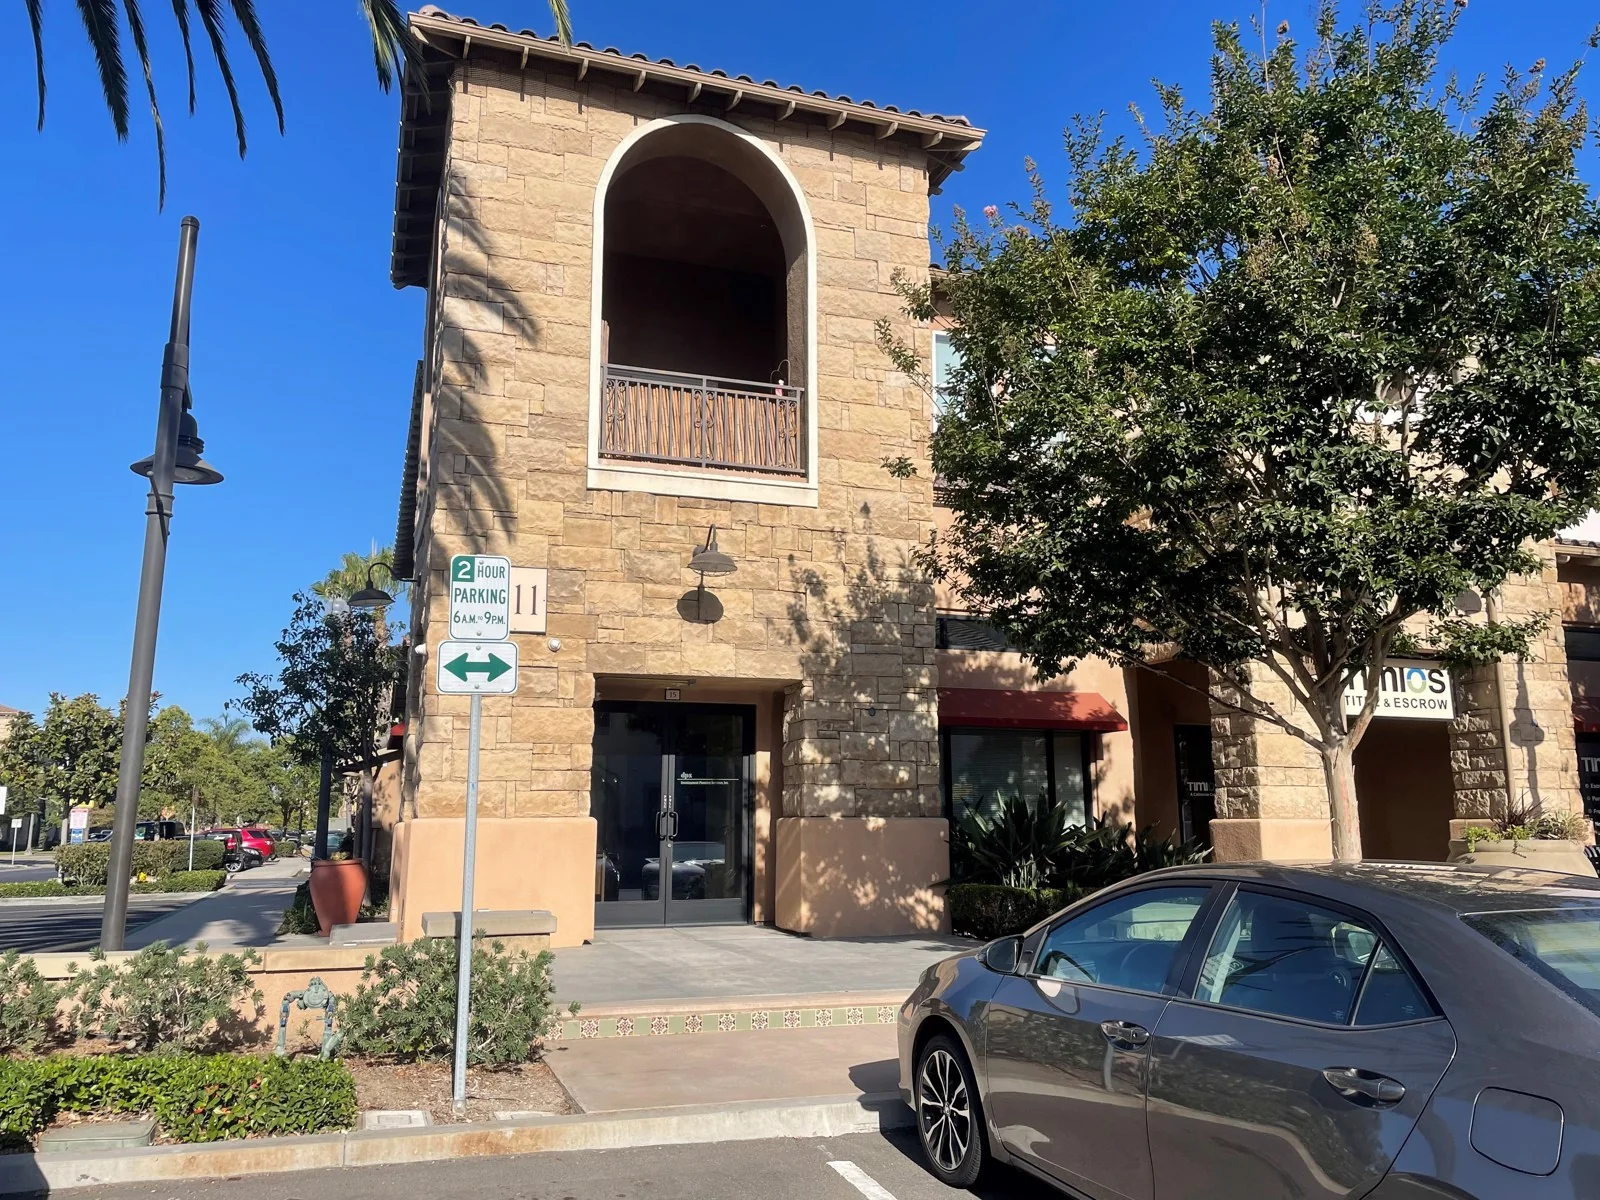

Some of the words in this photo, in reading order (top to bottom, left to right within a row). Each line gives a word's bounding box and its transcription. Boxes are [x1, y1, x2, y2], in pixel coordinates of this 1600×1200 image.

[457, 560, 471, 579] 2
[477, 565, 506, 579] HOUR
[454, 587, 506, 605] PARKING
[515, 584, 538, 616] 11
[1383, 698, 1391, 707] &
[1394, 697, 1448, 710] ESCROW
